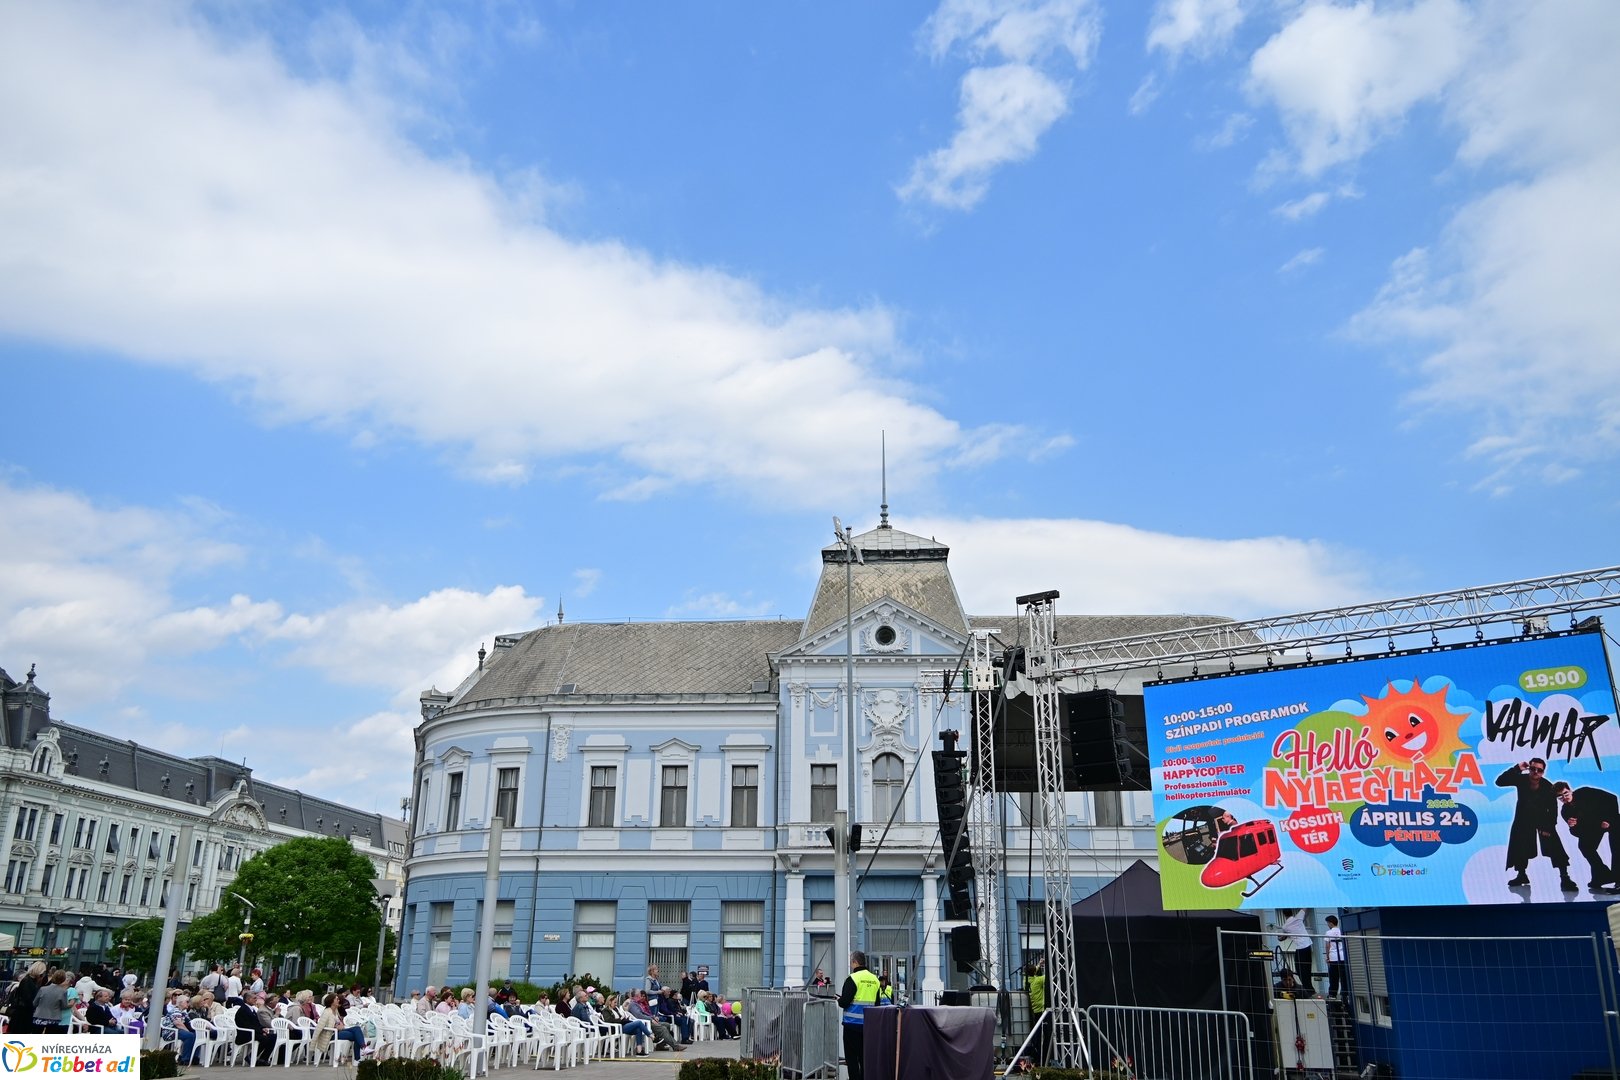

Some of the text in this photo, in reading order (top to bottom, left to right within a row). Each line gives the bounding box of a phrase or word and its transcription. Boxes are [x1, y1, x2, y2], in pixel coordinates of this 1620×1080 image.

[1525, 670, 1580, 689] 19:00
[1163, 703, 1233, 726] 10:00-15:00
[1165, 702, 1309, 740] SZÍNPADI PROGRAMOK
[1485, 697, 1610, 771] VALMAR
[1273, 727, 1379, 773] Helló
[1162, 755, 1217, 767] 10:00-18:00
[1163, 764, 1245, 780] HAPPYCOPTER
[1262, 751, 1485, 809] NYÍREGYHÁZA
[1164, 780, 1228, 791] Professzionális
[1165, 788, 1251, 801] helikopterszimulátor
[1280, 812, 1344, 832] KOSSUTH
[1360, 808, 1470, 826] ÁPRILIS 24.
[1302, 828, 1329, 845] TÉR
[1384, 827, 1442, 842] PÉNTEK
